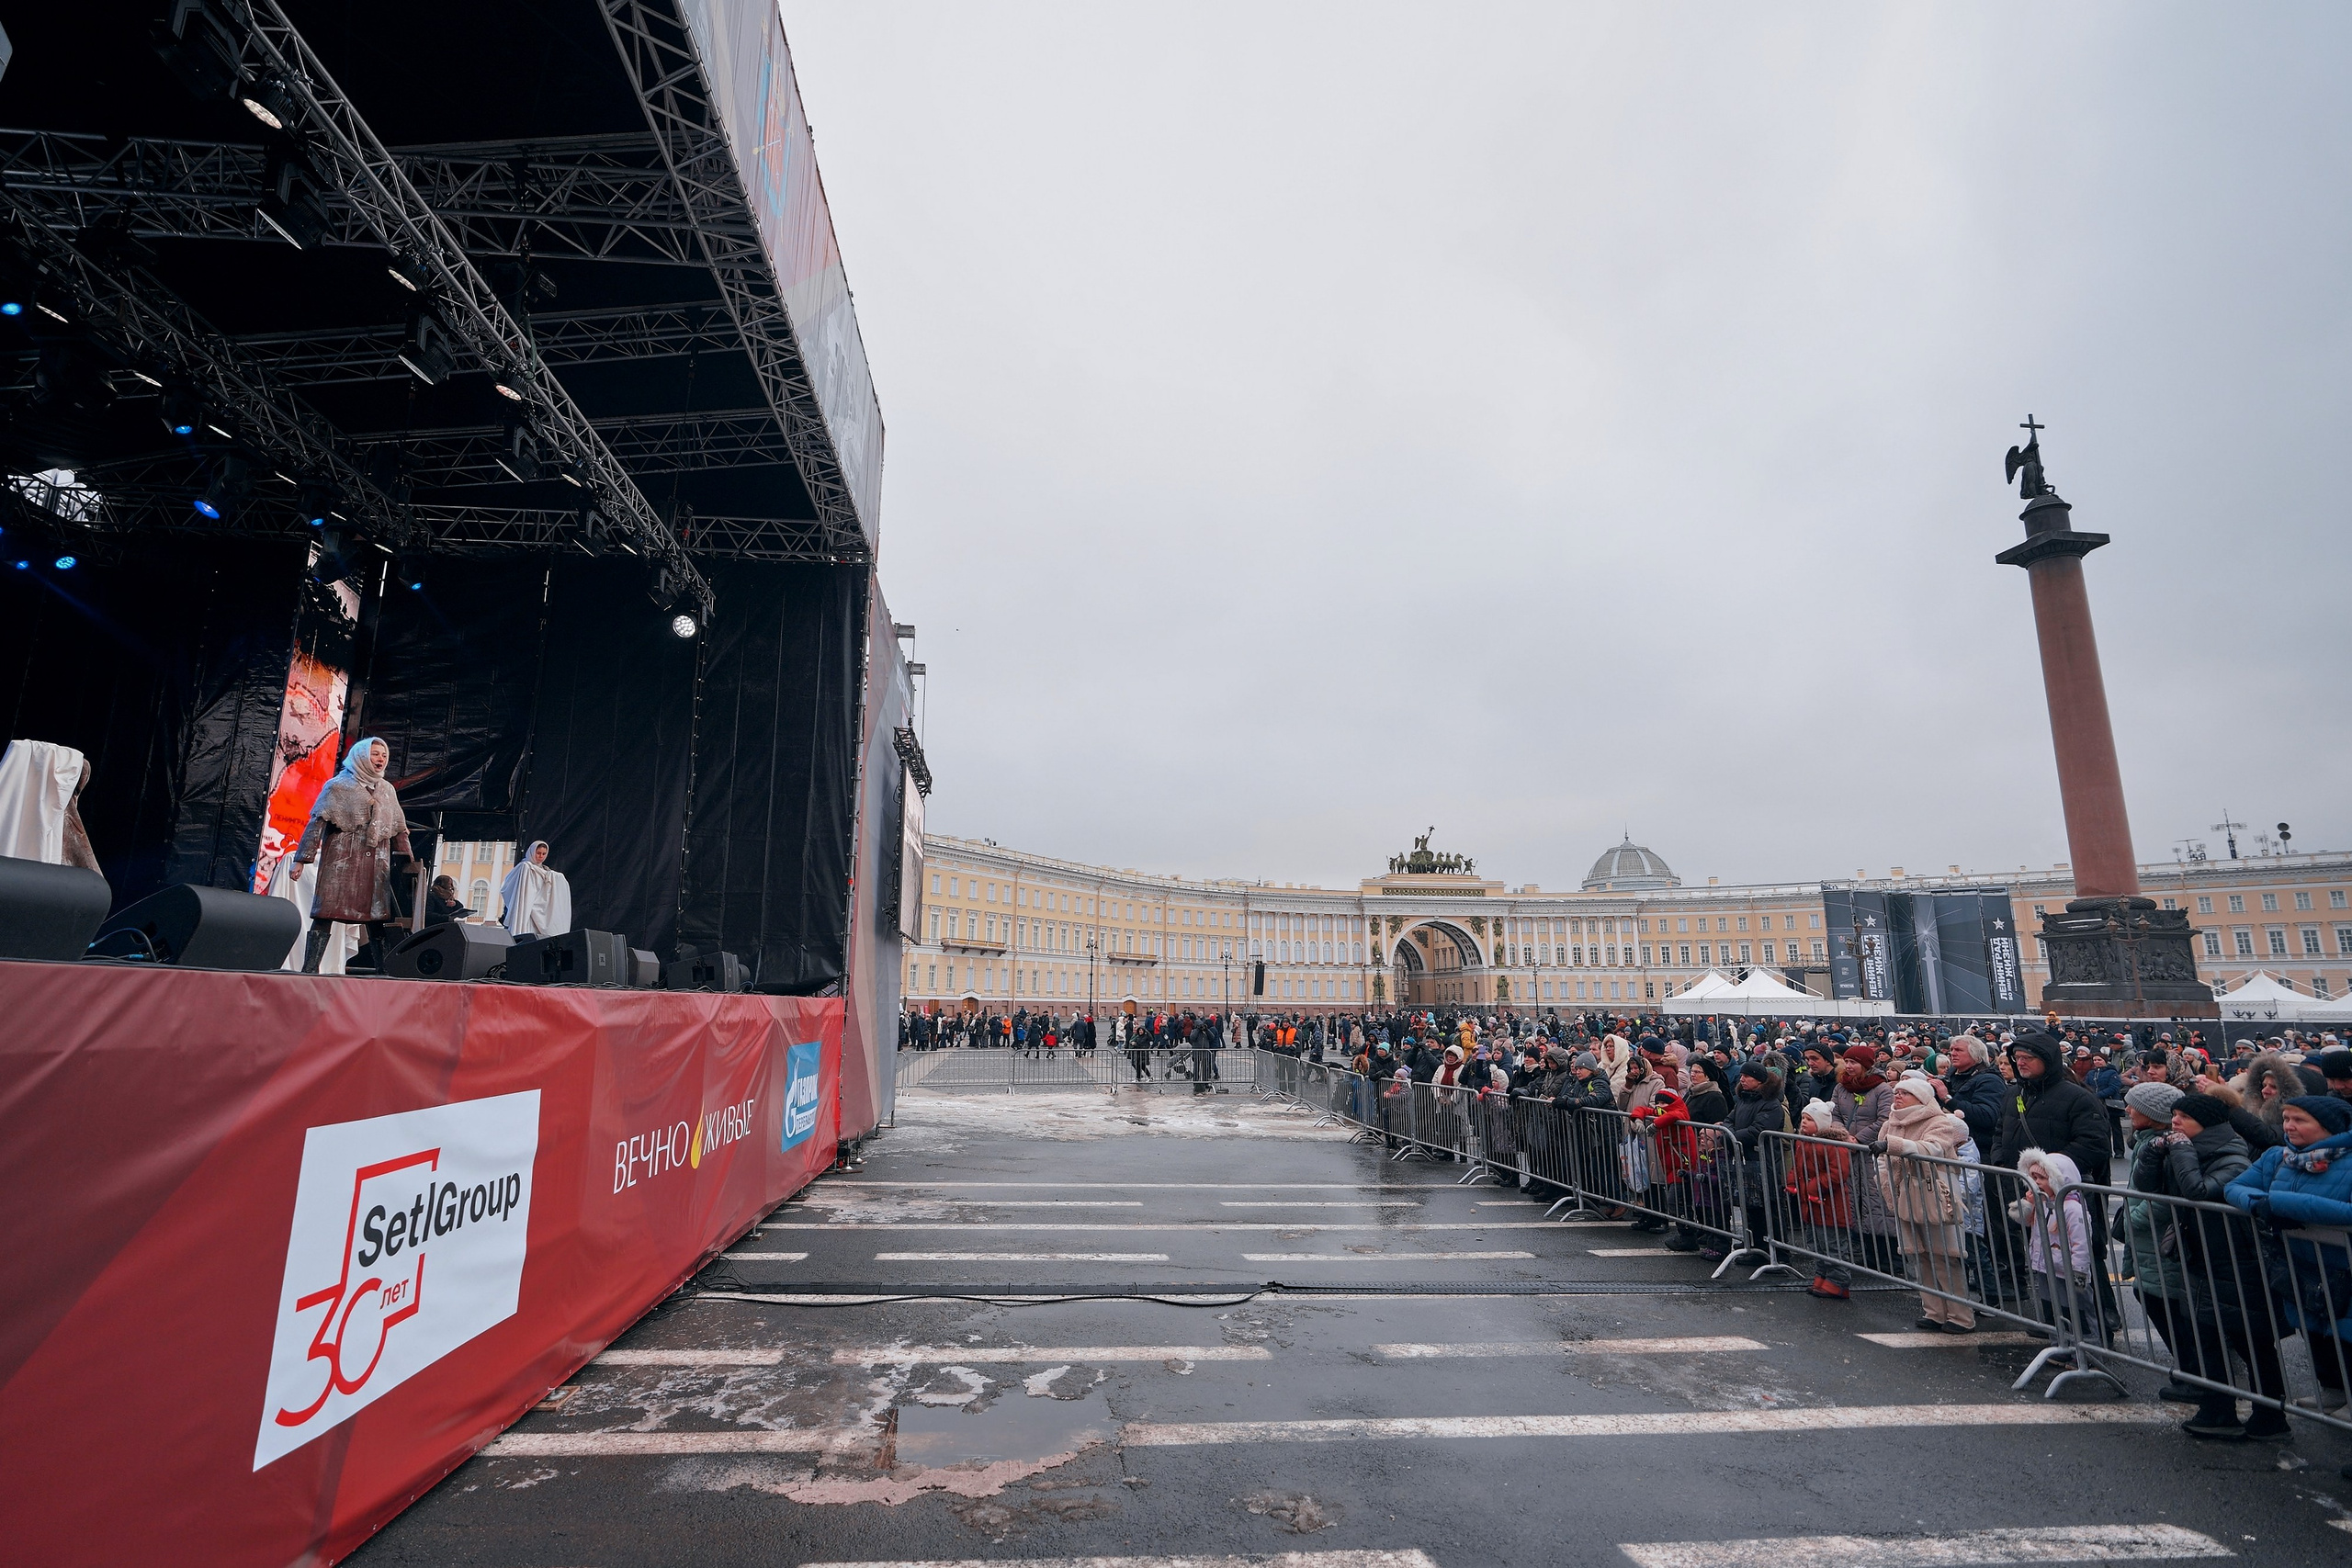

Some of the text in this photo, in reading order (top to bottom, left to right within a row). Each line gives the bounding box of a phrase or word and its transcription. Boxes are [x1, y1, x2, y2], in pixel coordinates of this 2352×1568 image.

[1871, 934, 1883, 975] ЖИЗНИ
[1993, 937, 2008, 1000] ЛЕНИНГРАД
[2001, 937, 2013, 977] ЖИЗНИ
[613, 1099, 754, 1195] ВЕЧНО ЖИВЫЕ
[379, 1278, 410, 1310] лет
[275, 1277, 388, 1427] 30
